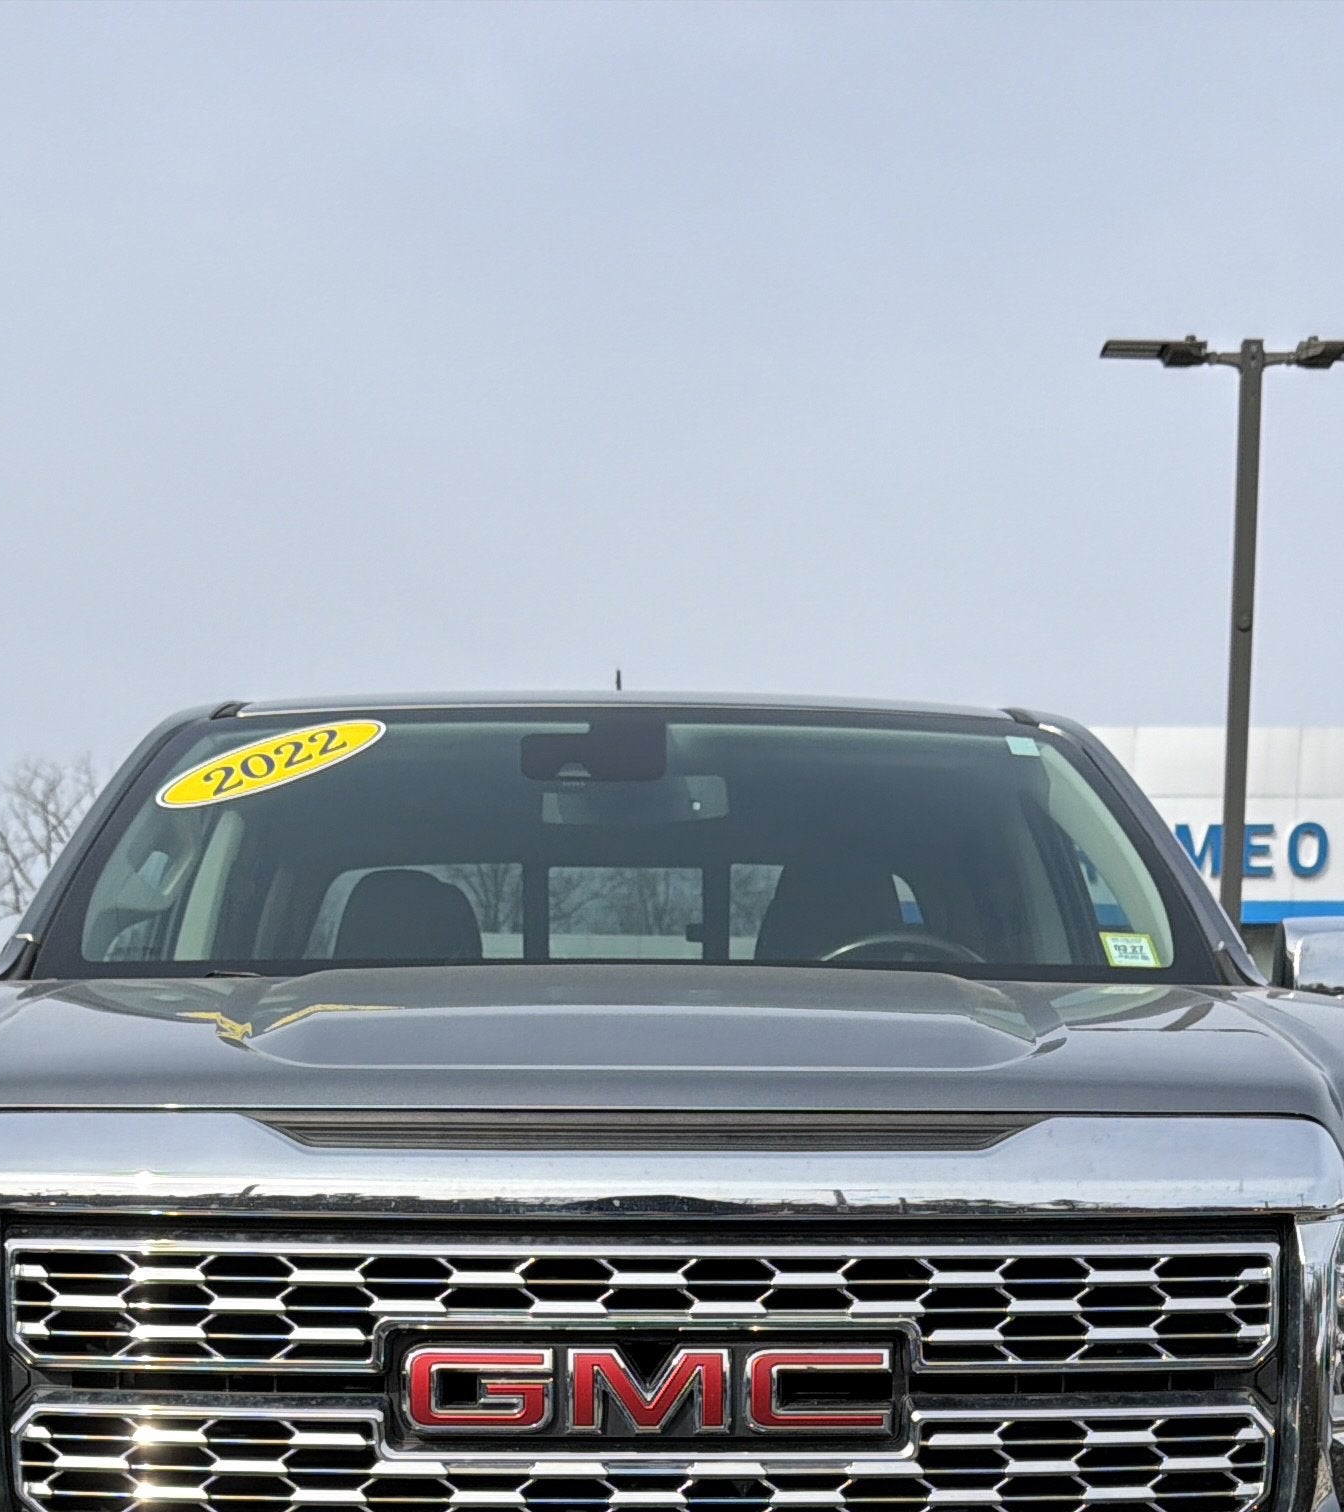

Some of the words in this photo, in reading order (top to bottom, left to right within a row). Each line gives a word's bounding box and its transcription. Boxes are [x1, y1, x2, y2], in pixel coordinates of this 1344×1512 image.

[203, 729, 348, 797] 2022
[1172, 822, 1329, 878] MEO
[403, 1346, 894, 1436] GMC
